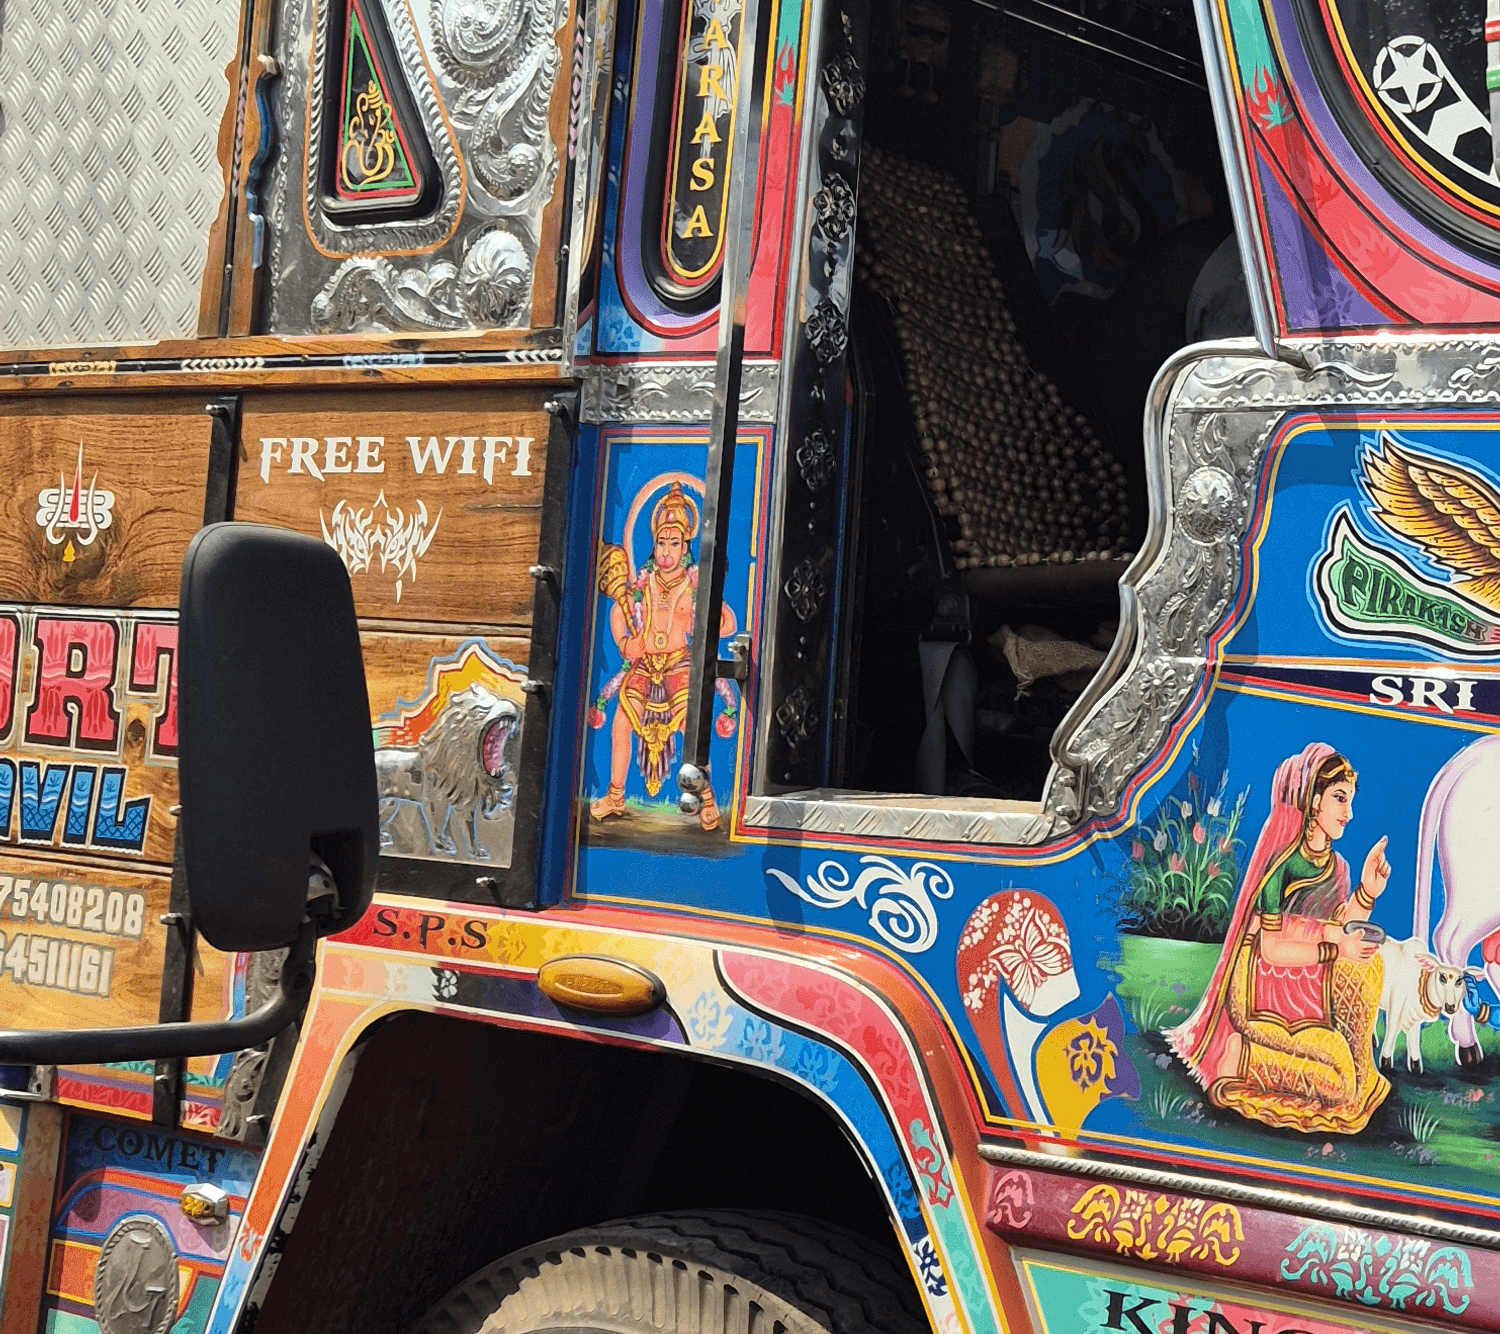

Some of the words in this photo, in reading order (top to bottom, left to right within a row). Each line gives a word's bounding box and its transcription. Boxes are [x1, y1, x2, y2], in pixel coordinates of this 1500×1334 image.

[258, 436, 386, 485] FREE
[405, 435, 532, 483] WIFI
[1341, 555, 1488, 642] PIRAKASH
[1369, 676, 1477, 715] SRI
[373, 908, 487, 949] S.P.S
[0, 930, 114, 998] 4511161
[93, 1126, 226, 1174] COMET
